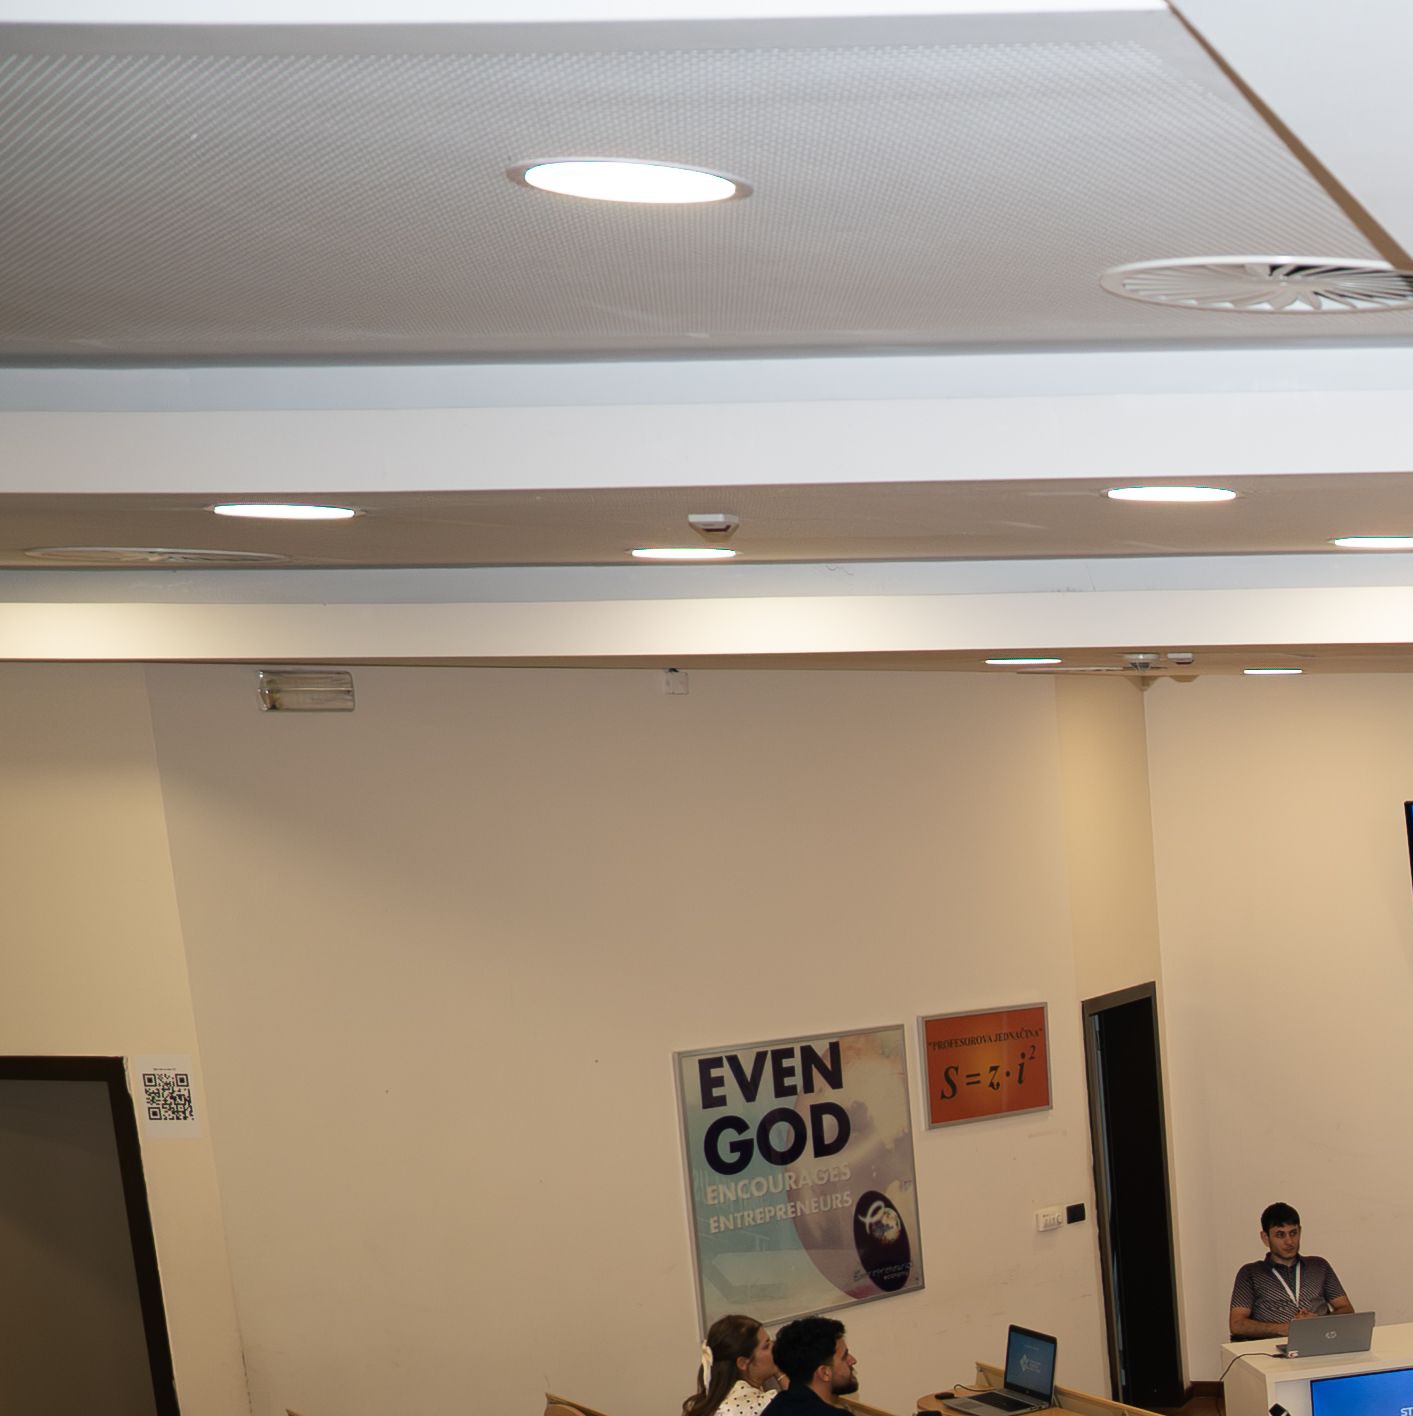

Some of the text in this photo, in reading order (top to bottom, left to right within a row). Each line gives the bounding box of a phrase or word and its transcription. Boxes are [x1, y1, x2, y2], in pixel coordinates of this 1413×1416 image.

[698, 1040, 844, 1110] EVEN
[940, 1064, 959, 1100] S
[704, 1102, 851, 1176] GOD
[706, 1164, 851, 1206] ENCOURAGES
[709, 1192, 852, 1234] ENTREPRENEURS
